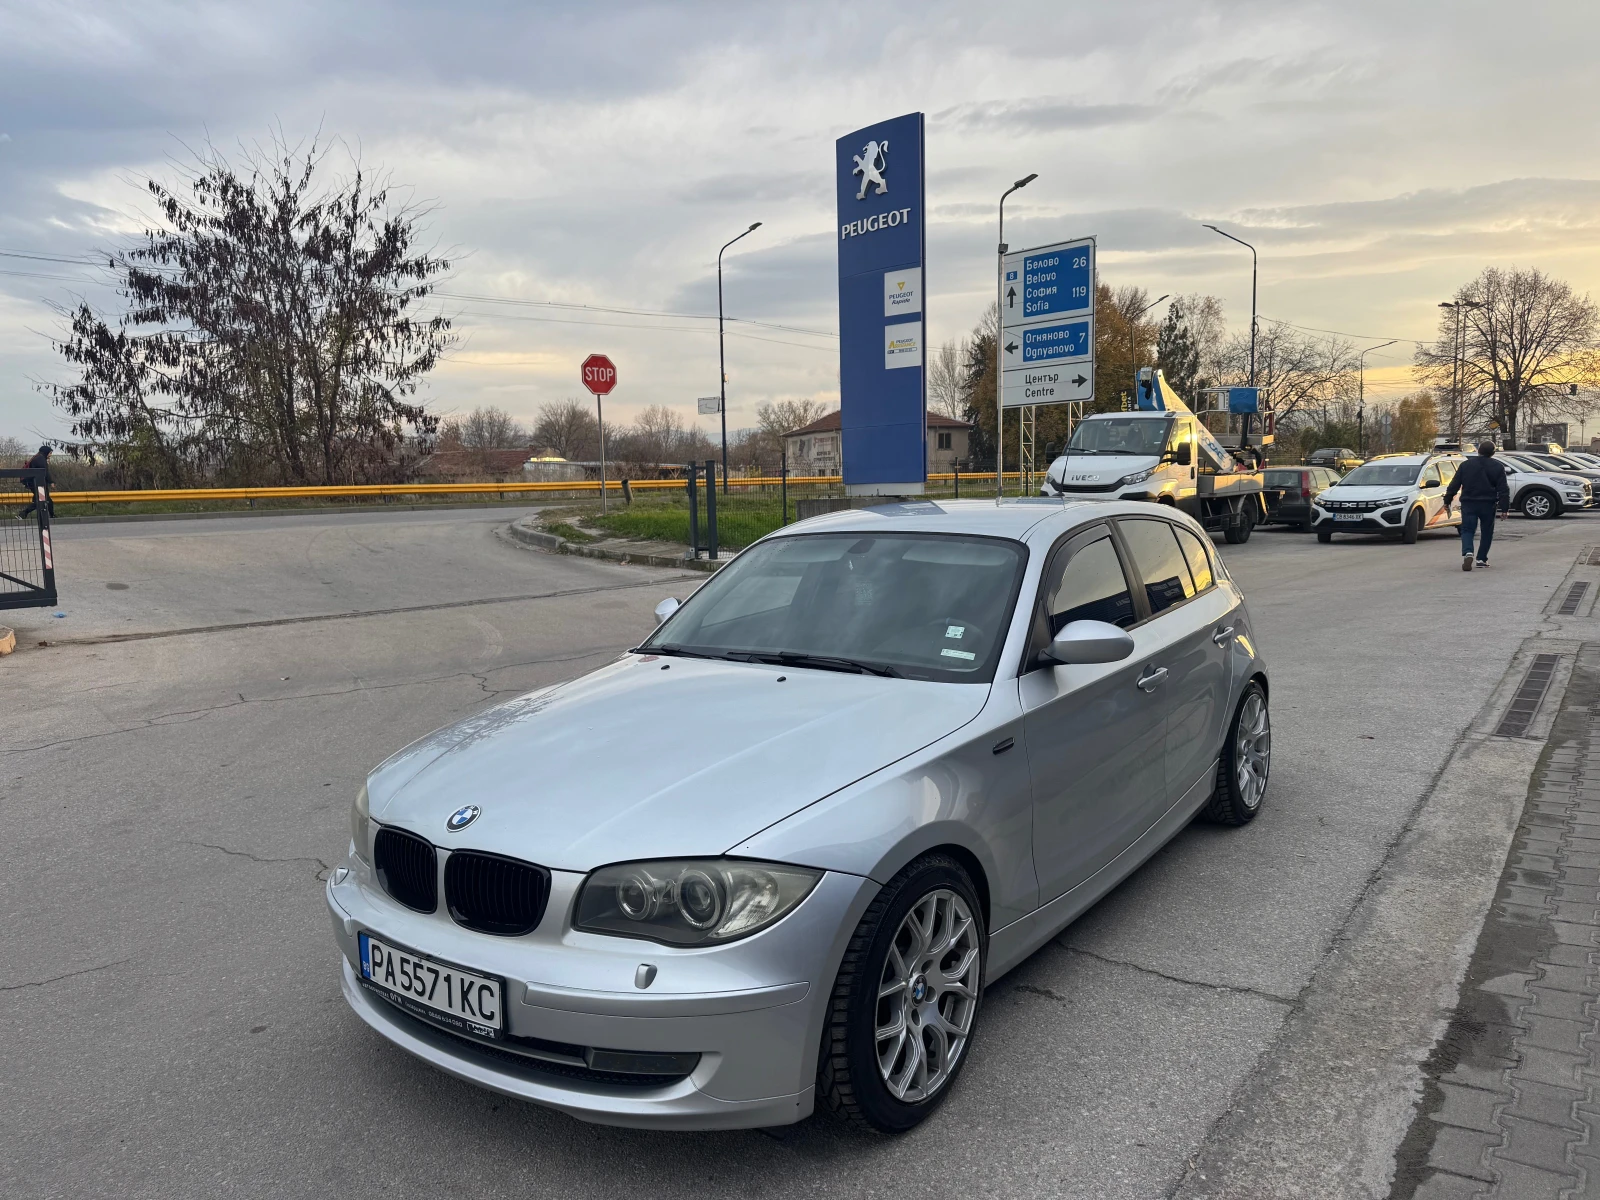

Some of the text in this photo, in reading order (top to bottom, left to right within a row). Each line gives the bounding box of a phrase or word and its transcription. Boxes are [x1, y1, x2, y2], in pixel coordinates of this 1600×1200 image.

[842, 208, 911, 240] PEUGEOT
[1026, 256, 1087, 271] Белово 26
[1009, 272, 1057, 285] 8 Belovo
[889, 291, 914, 300] PEUGEOT
[1026, 286, 1087, 299] София 119
[1026, 301, 1049, 312] Sofia
[1025, 330, 1086, 343] Огняново 7
[1025, 344, 1075, 359] Ognyanovo
[585, 366, 614, 382] STOP
[1025, 373, 1059, 385] Център
[1025, 387, 1055, 398] Centre
